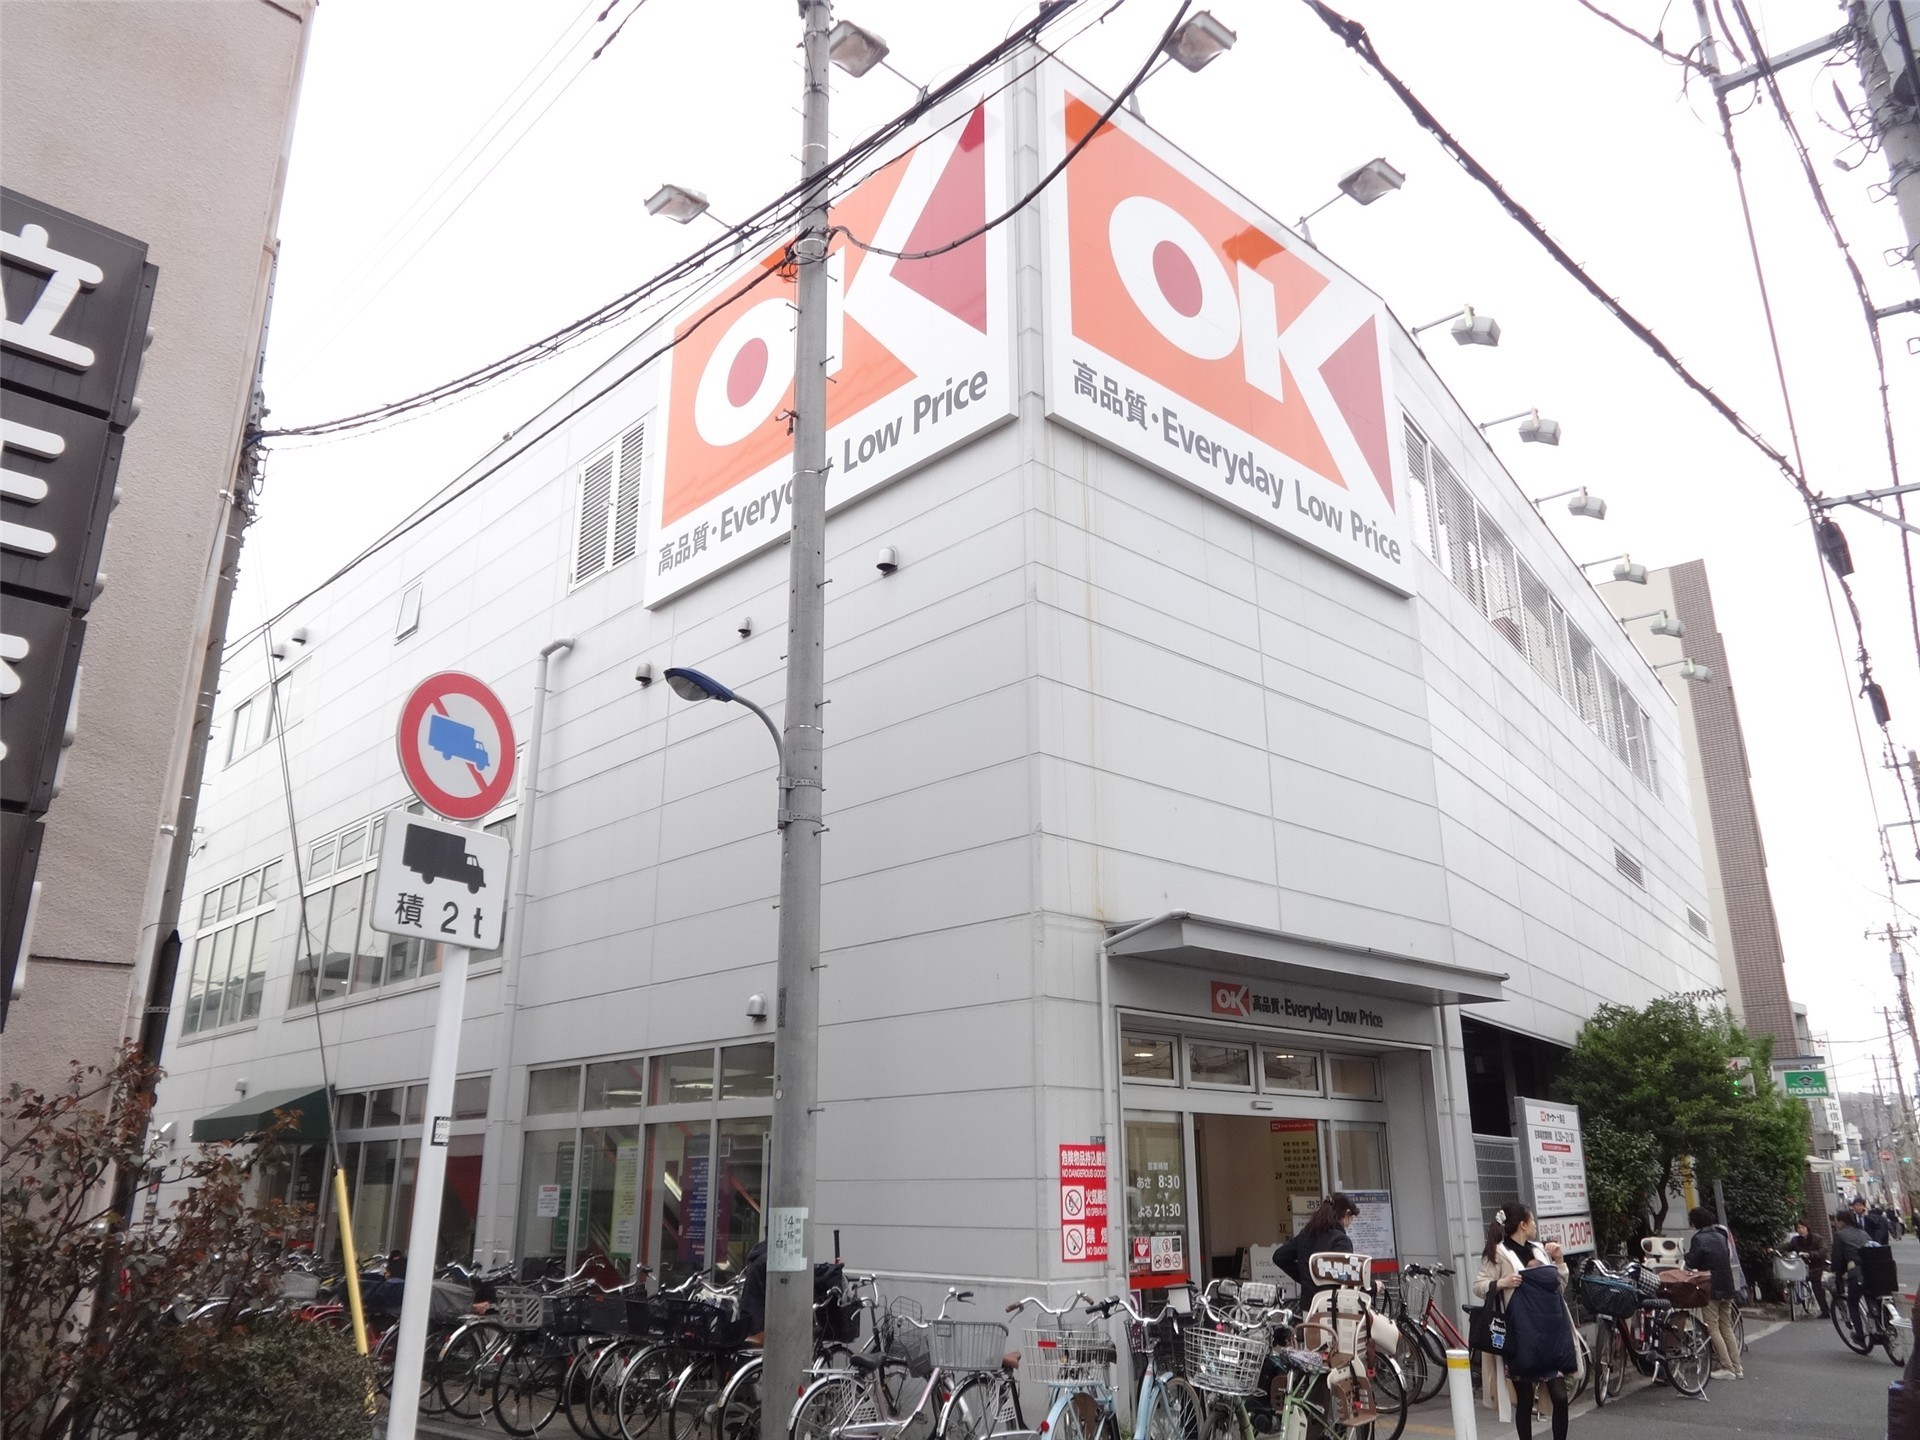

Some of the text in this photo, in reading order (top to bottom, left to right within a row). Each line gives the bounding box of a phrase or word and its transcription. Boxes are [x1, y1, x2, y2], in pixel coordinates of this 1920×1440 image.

[1108, 194, 1396, 518] OK
[843, 416, 904, 474] Low
[912, 370, 989, 435] Price
[1162, 406, 1285, 510] Everyday
[1294, 478, 1344, 534] Low
[1350, 508, 1402, 565] Price
[1216, 986, 1250, 1017] OK
[1284, 997, 1333, 1026] Everyday
[1336, 1006, 1357, 1025] Low
[1359, 1009, 1383, 1028] Price
[1787, 1086, 1828, 1095] KOBAN
[1136, 1174, 1180, 1189] あさ 8:30
[1137, 1203, 1181, 1218] よる 21:30
